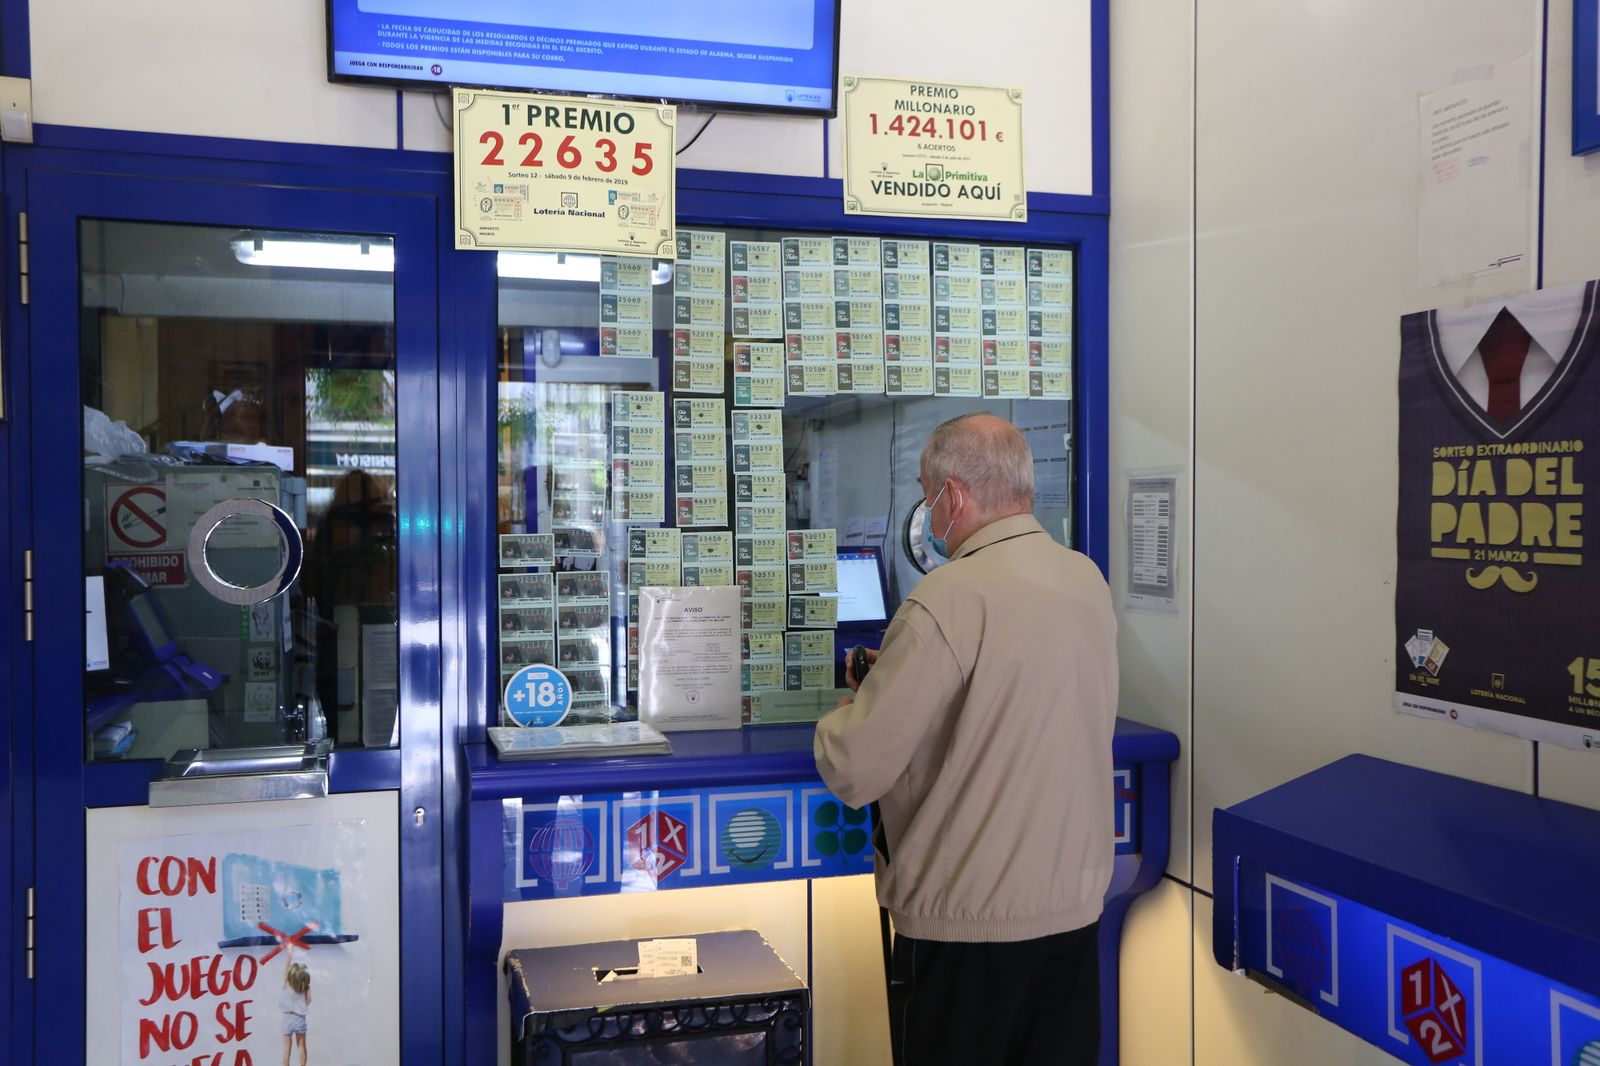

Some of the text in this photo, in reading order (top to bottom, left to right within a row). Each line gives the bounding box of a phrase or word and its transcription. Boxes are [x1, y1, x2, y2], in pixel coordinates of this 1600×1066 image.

[377, 30, 408, 40] DURANTE
[420, 34, 450, 43] VIGENCIA
[423, 26, 461, 36] CADUCIDAD
[462, 29, 471, 37] DE
[471, 30, 484, 38] LOS
[603, 40, 616, 49] QUE
[640, 43, 668, 53] DURANTE
[676, 47, 699, 56] ESTADO
[382, 41, 405, 50] TODOS
[420, 44, 447, 53] PREMIOS
[471, 48, 513, 58] DISPONIBLES
[514, 51, 530, 59] PARA
[910, 85, 959, 99] PREMIO
[894, 99, 976, 116] MILLONARIO
[527, 104, 635, 135] PREMIO
[869, 113, 1004, 142] 1.424.101 €
[479, 130, 654, 177] 22635
[923, 144, 956, 152] ACIERTOS
[508, 171, 529, 180] Sorteo
[544, 172, 567, 180] sábado
[582, 175, 604, 184] febrero
[912, 170, 988, 181] La Primitiva
[871, 180, 1001, 200] VENDIDO AQUÍ
[534, 207, 606, 218] Lotería Nacional
[1433, 440, 1584, 458] SORTEO EXTRAORDINARIO
[1506, 456, 1584, 496] DEL
[1431, 502, 1583, 548] PADRE
[1474, 550, 1529, 563] 21 MARZO
[513, 681, 556, 708] +18
[556, 682, 564, 705] AÑOS
[1495, 692, 1526, 704] NACIONAL
[136, 855, 217, 897] CON
[137, 907, 182, 954] EL
[139, 953, 258, 1006] JUEGO
[139, 999, 254, 1060] NO SE
